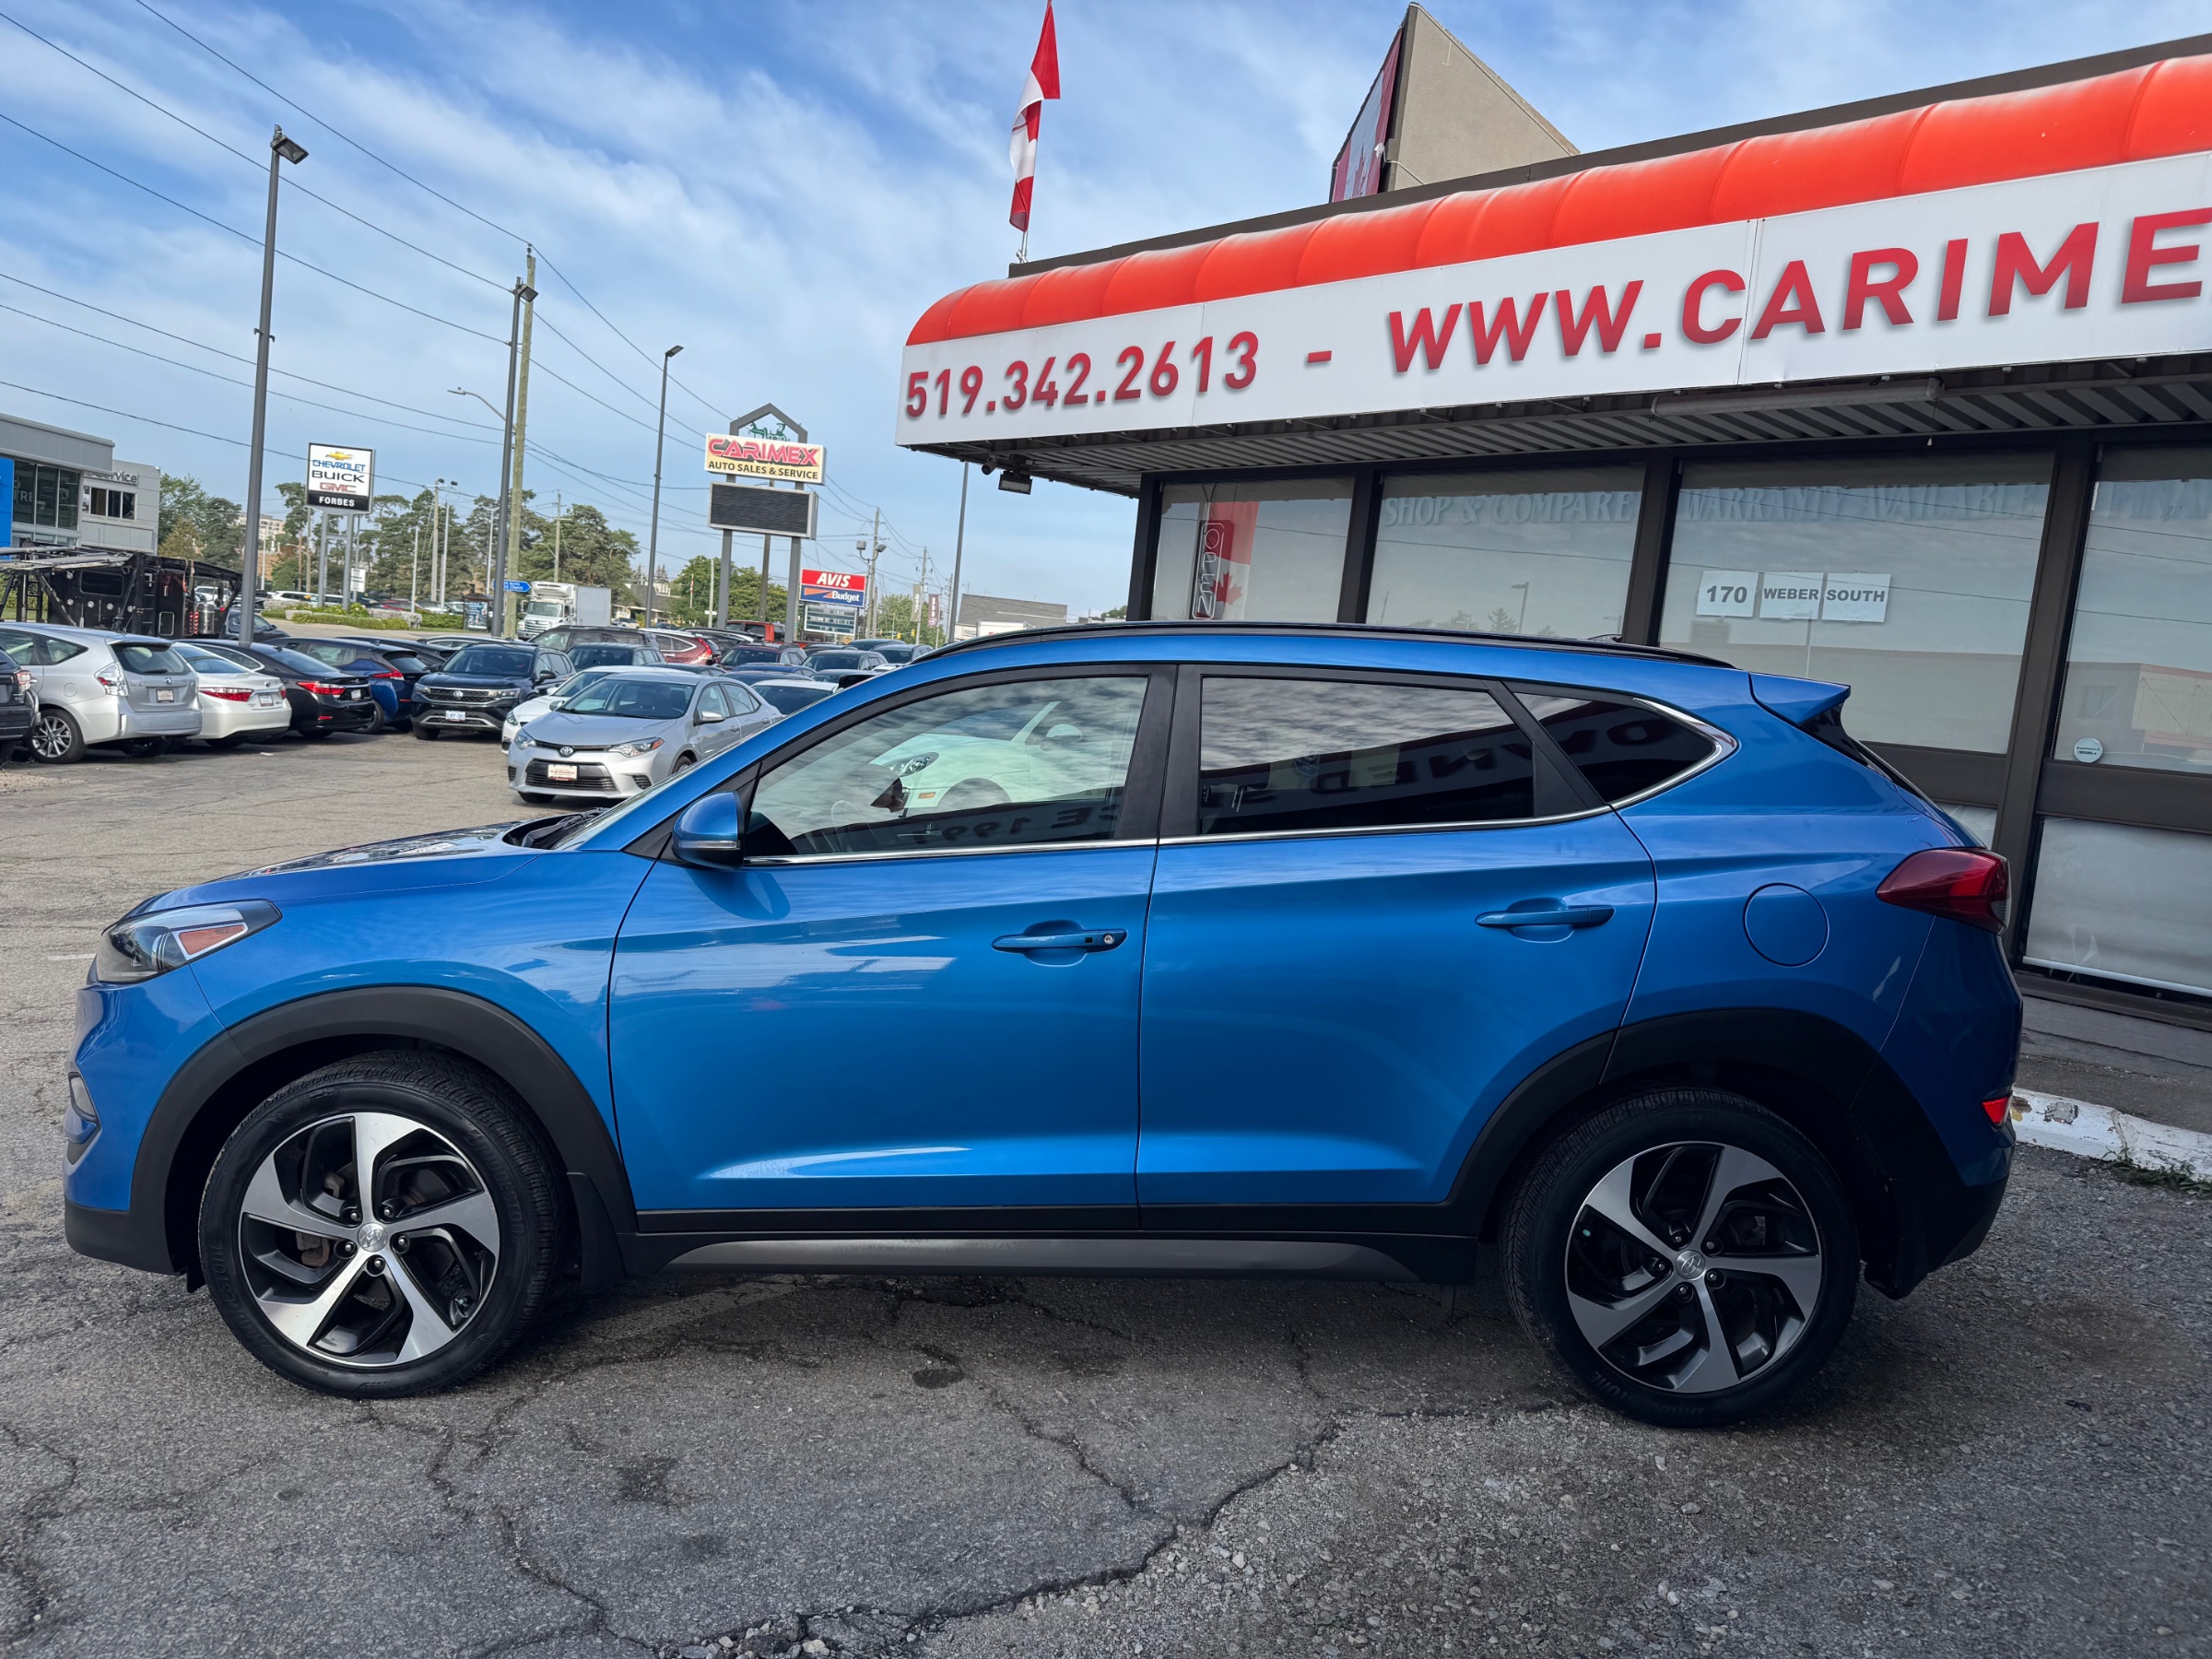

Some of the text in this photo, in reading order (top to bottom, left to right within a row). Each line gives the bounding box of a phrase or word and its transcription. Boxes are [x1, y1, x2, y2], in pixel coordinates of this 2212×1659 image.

[906, 331, 1259, 418] 519.342.2613
[708, 438, 819, 466] CARIMEX
[312, 459, 366, 472] CHEVROLET
[708, 461, 818, 479] AUTO SALES & SERVICE
[312, 469, 365, 483] BUICK
[320, 482, 357, 493] GMC
[319, 497, 355, 507] FORBES
[1382, 496, 1452, 526] SHOP
[1492, 491, 1635, 524] COMPARE
[816, 572, 852, 588] AVIS
[832, 591, 859, 603] Budget
[1706, 585, 1886, 604] 170 WEBER SOUTH
